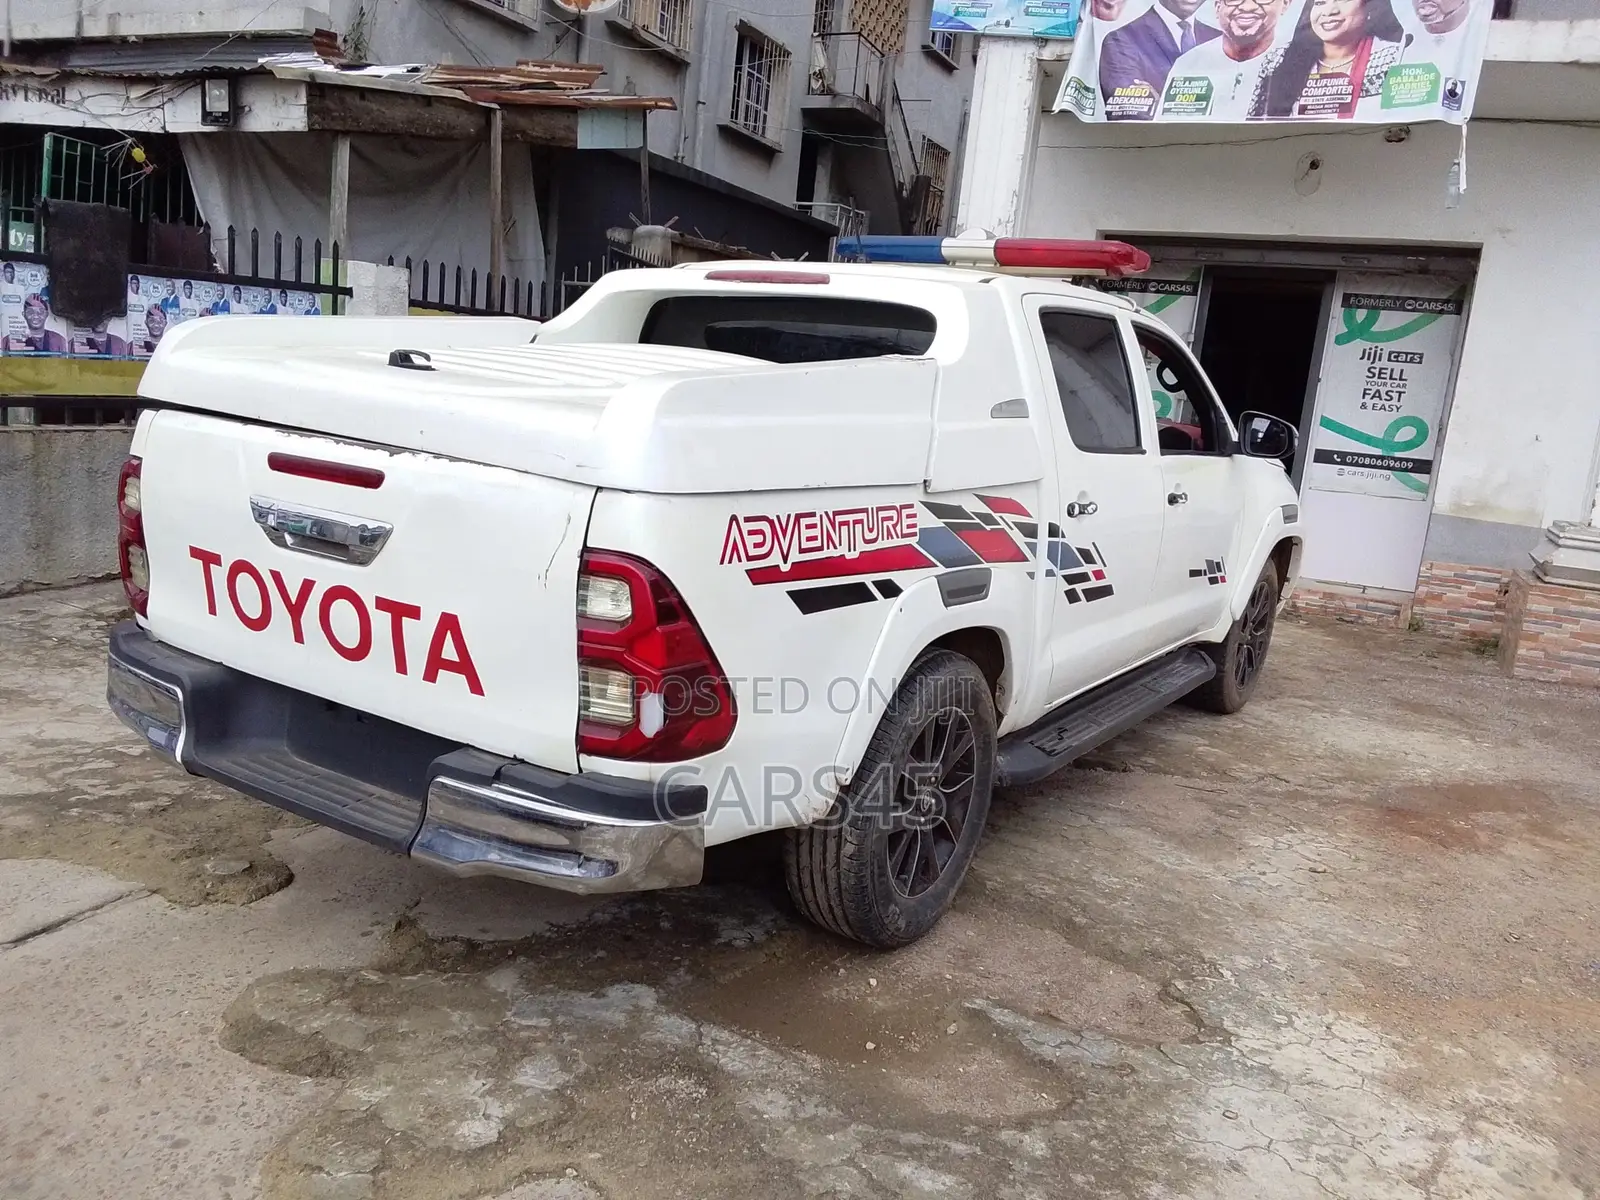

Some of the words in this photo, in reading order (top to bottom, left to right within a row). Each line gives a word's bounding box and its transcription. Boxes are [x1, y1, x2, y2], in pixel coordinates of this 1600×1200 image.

[1306, 77, 1350, 88] OLUFUNKE
[1114, 87, 1151, 97] BIMBO
[1302, 85, 1354, 97] COMFORTER
[1175, 94, 1196, 102] DON
[1101, 280, 1146, 290] FORMERLY
[1349, 296, 1402, 308] FORMERLY
[1390, 353, 1421, 363] cars
[1366, 366, 1408, 382] SELL
[1365, 380, 1388, 388] YOUR
[1390, 381, 1407, 389] CAR
[1362, 388, 1406, 402] FAST
[1360, 401, 1368, 410] &
[1371, 402, 1403, 412] EASY
[1346, 455, 1414, 469] 07080609609
[719, 503, 919, 566] ADVENTURE
[189, 545, 486, 698] TOYOTA
